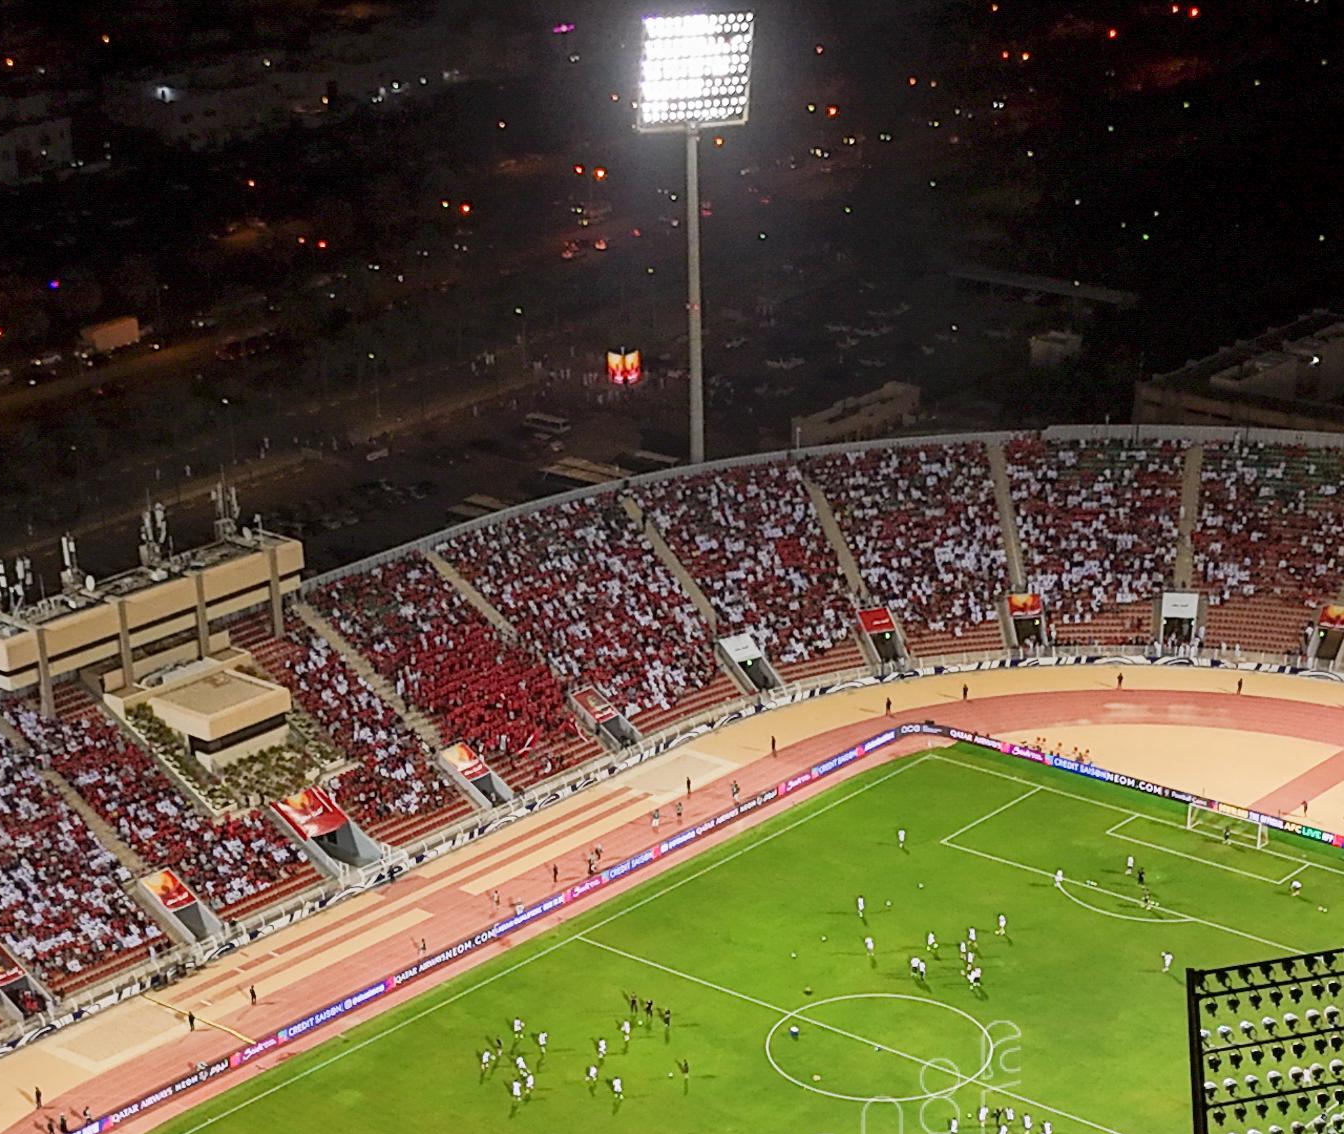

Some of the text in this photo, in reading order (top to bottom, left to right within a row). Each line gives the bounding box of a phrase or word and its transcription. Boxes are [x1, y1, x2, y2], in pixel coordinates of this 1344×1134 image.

[1106, 772, 1162, 795] NEOM.COM
[1284, 822, 1301, 835] AFC
[1301, 827, 1322, 840] LIVE
[288, 1018, 314, 1037] CREDIT
[174, 1075, 199, 1092] NEOM
[111, 1088, 174, 1124] QATAR AIRWAYS
